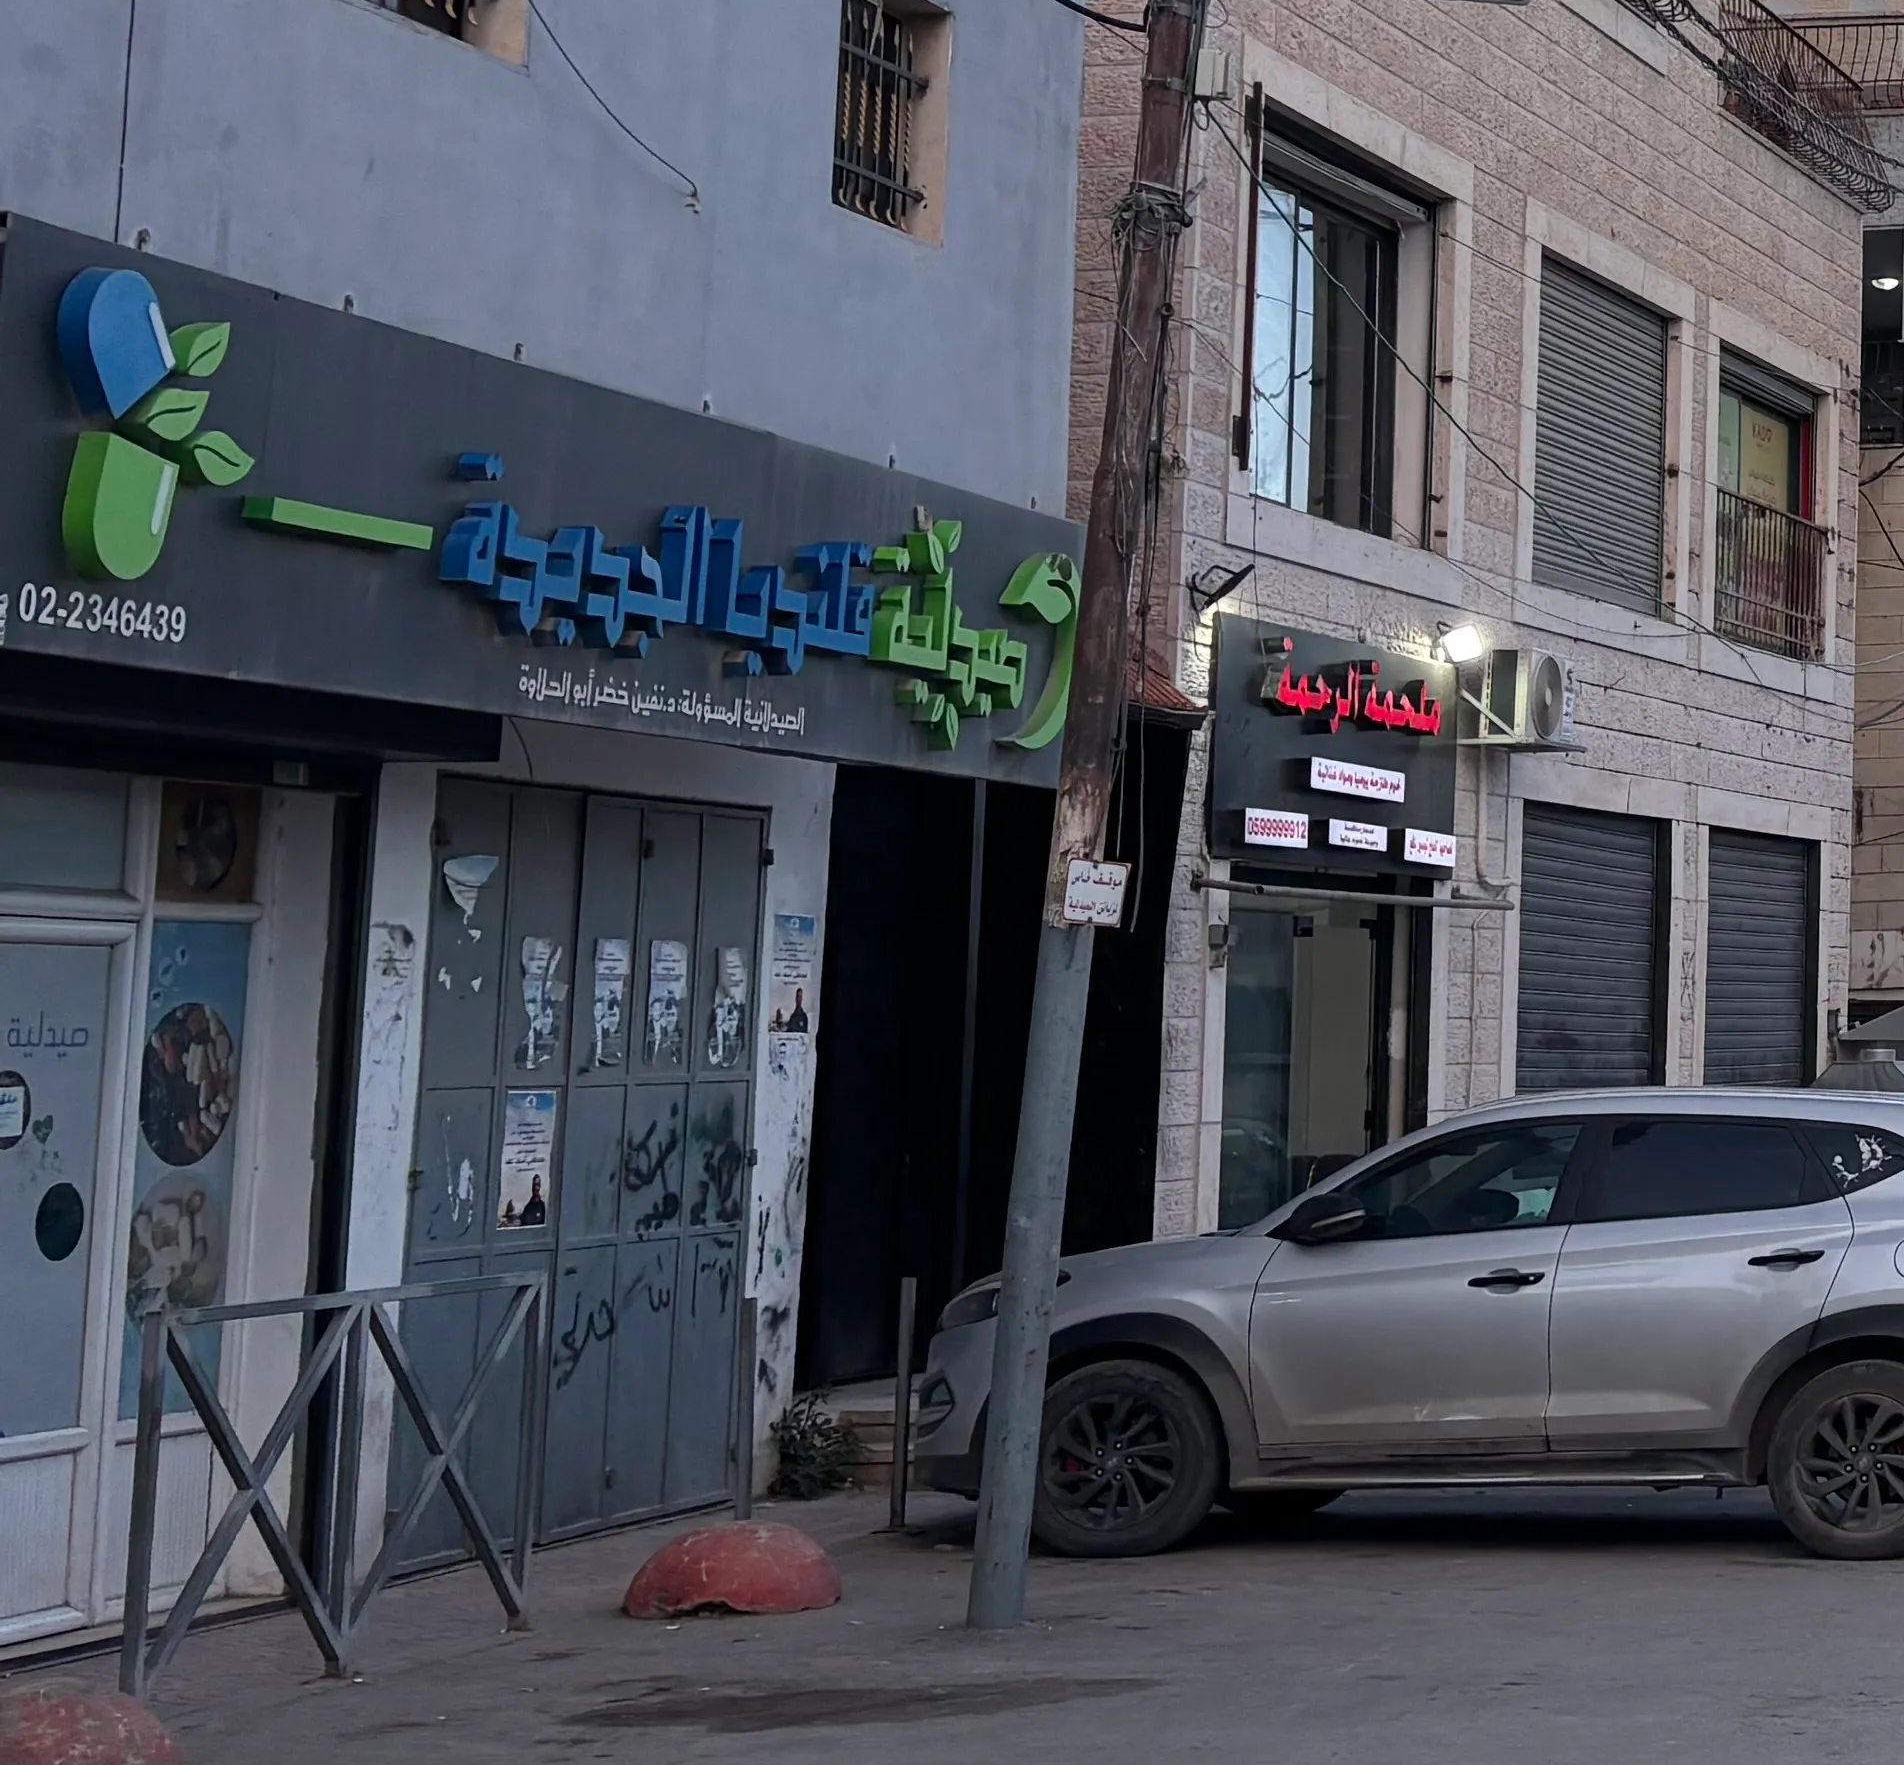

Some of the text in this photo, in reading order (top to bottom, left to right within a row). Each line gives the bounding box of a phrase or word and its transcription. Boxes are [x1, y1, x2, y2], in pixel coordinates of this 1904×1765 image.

[440, 452, 712, 660] الجديدة
[19, 582, 187, 643] 02-2346439
[872, 521, 1028, 751] صيدلية
[518, 664, 572, 705] الحلاوة
[573, 668, 594, 708] أبو
[593, 676, 629, 707] خضر
[1265, 636, 1442, 736] ملحمة الرحمة
[743, 699, 805, 736] الصيدلانية
[7, 1010, 90, 1059] صيدلية
